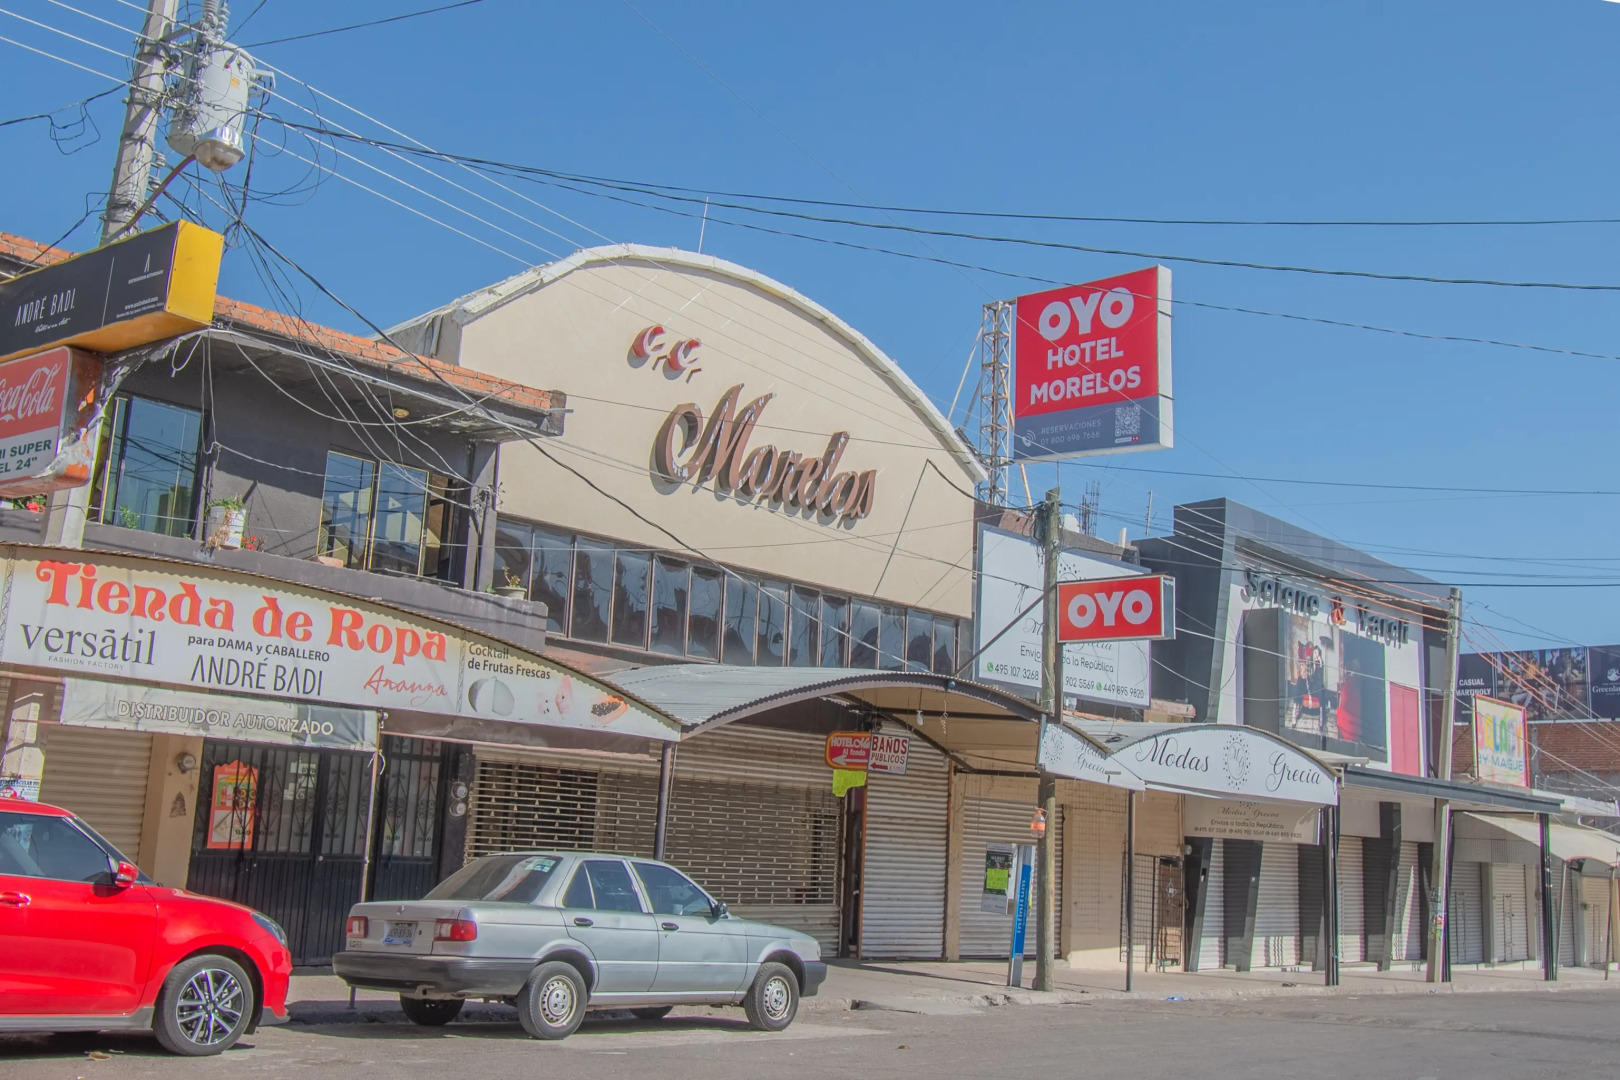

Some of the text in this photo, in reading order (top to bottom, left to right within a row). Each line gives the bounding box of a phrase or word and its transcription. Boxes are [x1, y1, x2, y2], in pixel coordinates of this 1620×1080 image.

[1038, 286, 1134, 341] OYO
[1047, 336, 1124, 370] HOTEL
[1030, 365, 1141, 405] MORELOS
[1040, 437, 1049, 446] 01
[1051, 435, 1065, 444] 800
[1041, 419, 1101, 435] RESERVACIONES
[9, 439, 52, 458] SUPER
[654, 382, 877, 520] Morelos
[36, 560, 448, 666] Tienda de Ropa
[1067, 589, 1153, 629] OYO
[187, 635, 330, 662] para DAMA y CABALLERO
[468, 643, 509, 660] Cocktail
[1020, 645, 1041, 659] Envio
[1072, 655, 1079, 666] la
[1081, 656, 1114, 673] República
[48, 655, 125, 671] FASHION FACTORY
[190, 654, 323, 696] ANDRÉ BADI
[467, 657, 551, 680] de Frutas Frescas
[994, 663, 1145, 699] 495 107 3268 902 5569 449 895 9820
[1458, 678, 1485, 687] CASUAL
[117, 700, 335, 736] DISTRIBUIDOR AUTORIZADO
[870, 752, 906, 765] PUBLICOS
[871, 735, 908, 755] BAÑOS
[1135, 735, 1210, 773] Modas
[1265, 751, 1320, 793] Grecia
[1210, 819, 1229, 827] Envios
[1255, 821, 1285, 830] República
[1216, 806, 1247, 817] Modas
